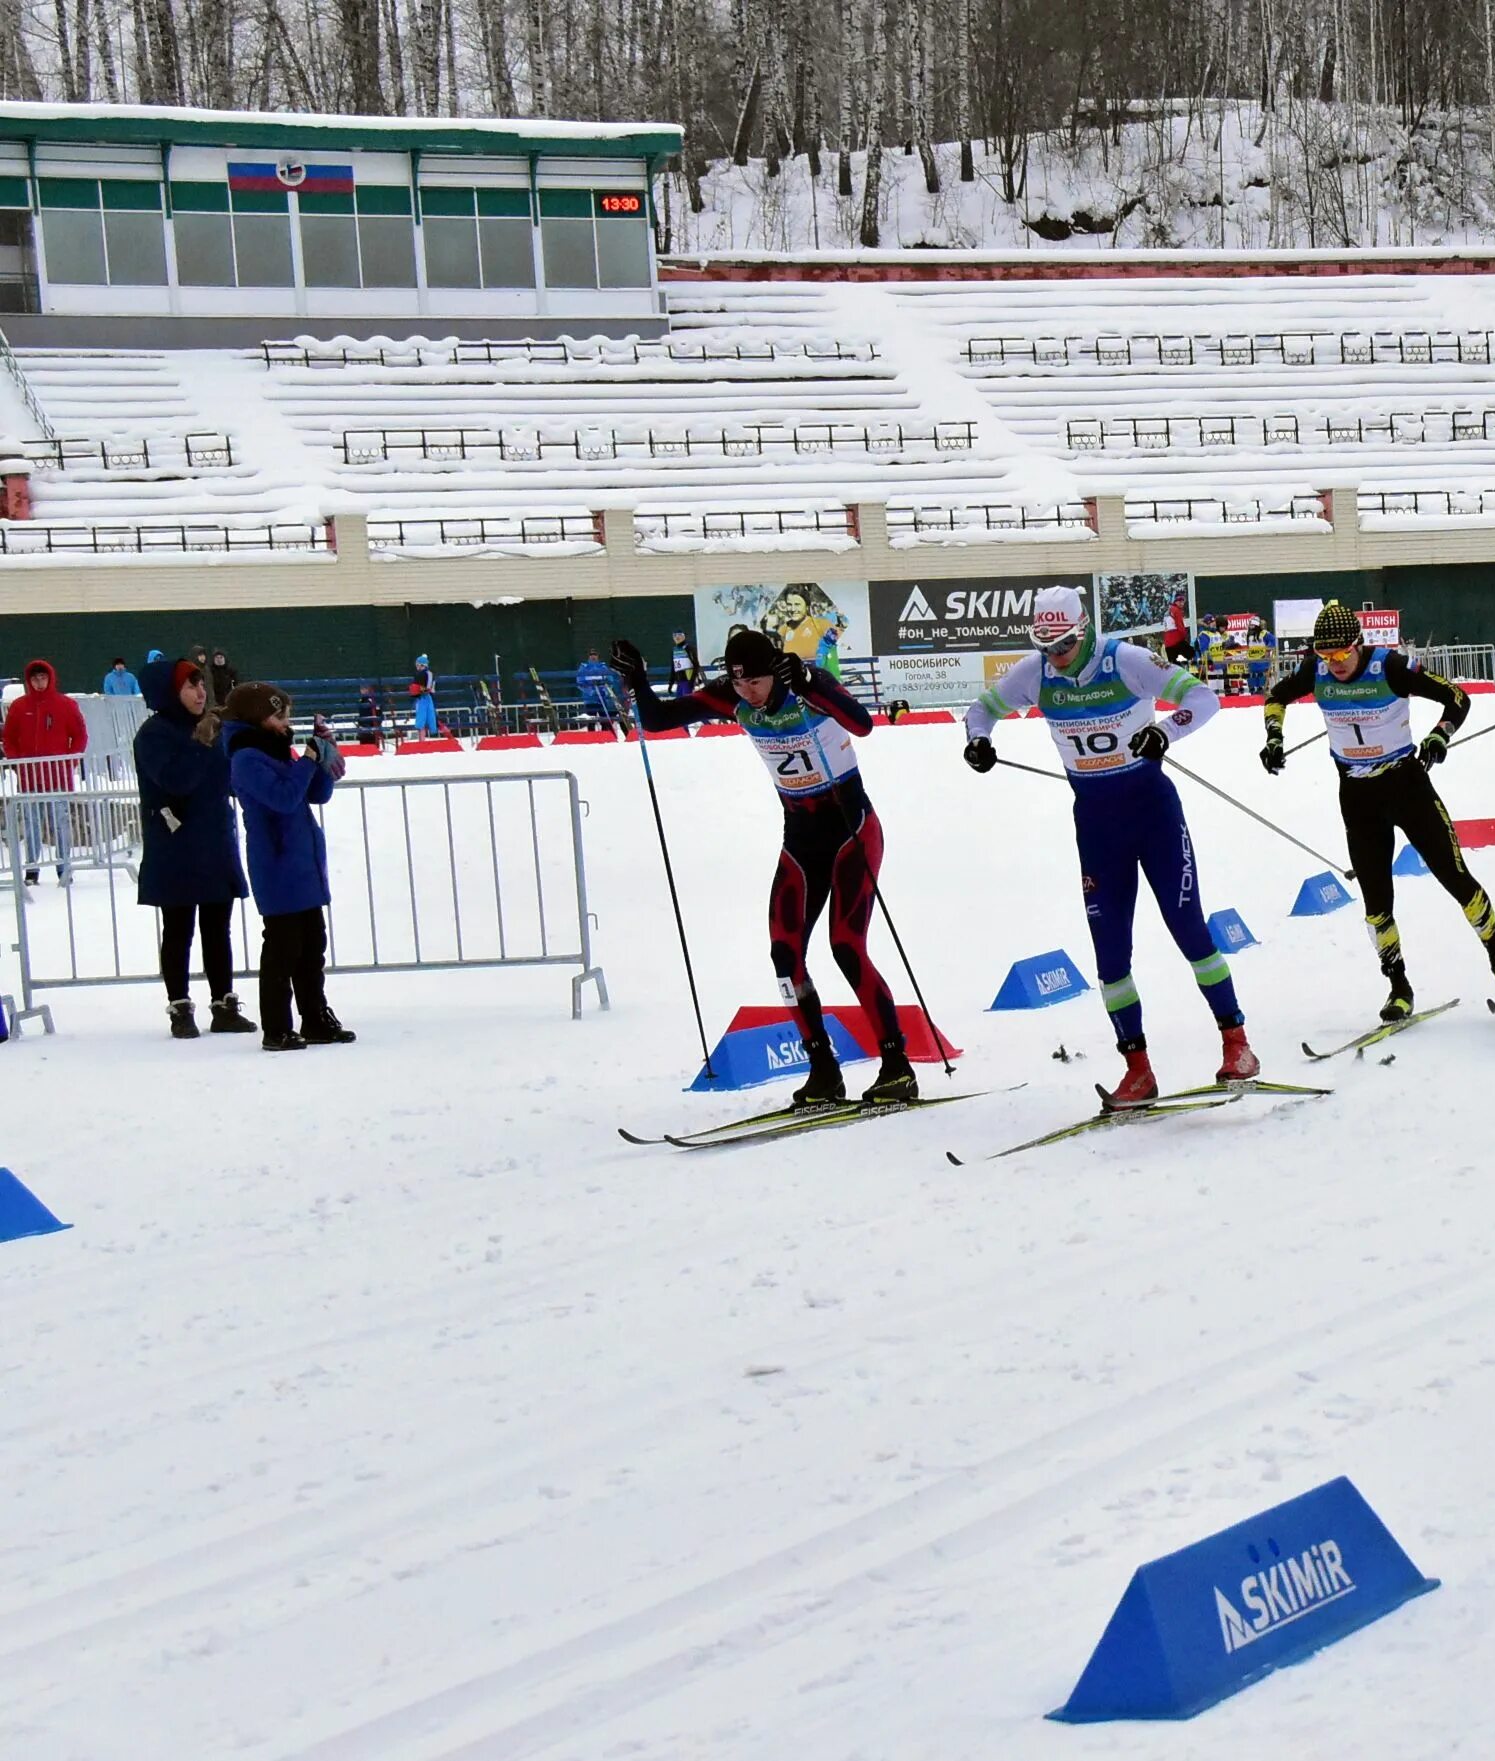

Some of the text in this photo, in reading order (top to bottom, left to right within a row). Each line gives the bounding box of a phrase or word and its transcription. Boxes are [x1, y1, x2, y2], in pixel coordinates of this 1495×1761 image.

[1366, 615, 1396, 627] FINISH
[889, 657, 961, 670] НОВОСИБИРСК
[905, 670, 947, 681] Гоголя, 38
[1099, 710, 1132, 724] РОССИИ
[1058, 722, 1123, 735] НОВОСИБИРСК
[1347, 722, 1365, 746] 1
[1067, 732, 1119, 756] 10
[768, 749, 814, 776] 21
[1241, 1539, 1354, 1628] SKIMiR
